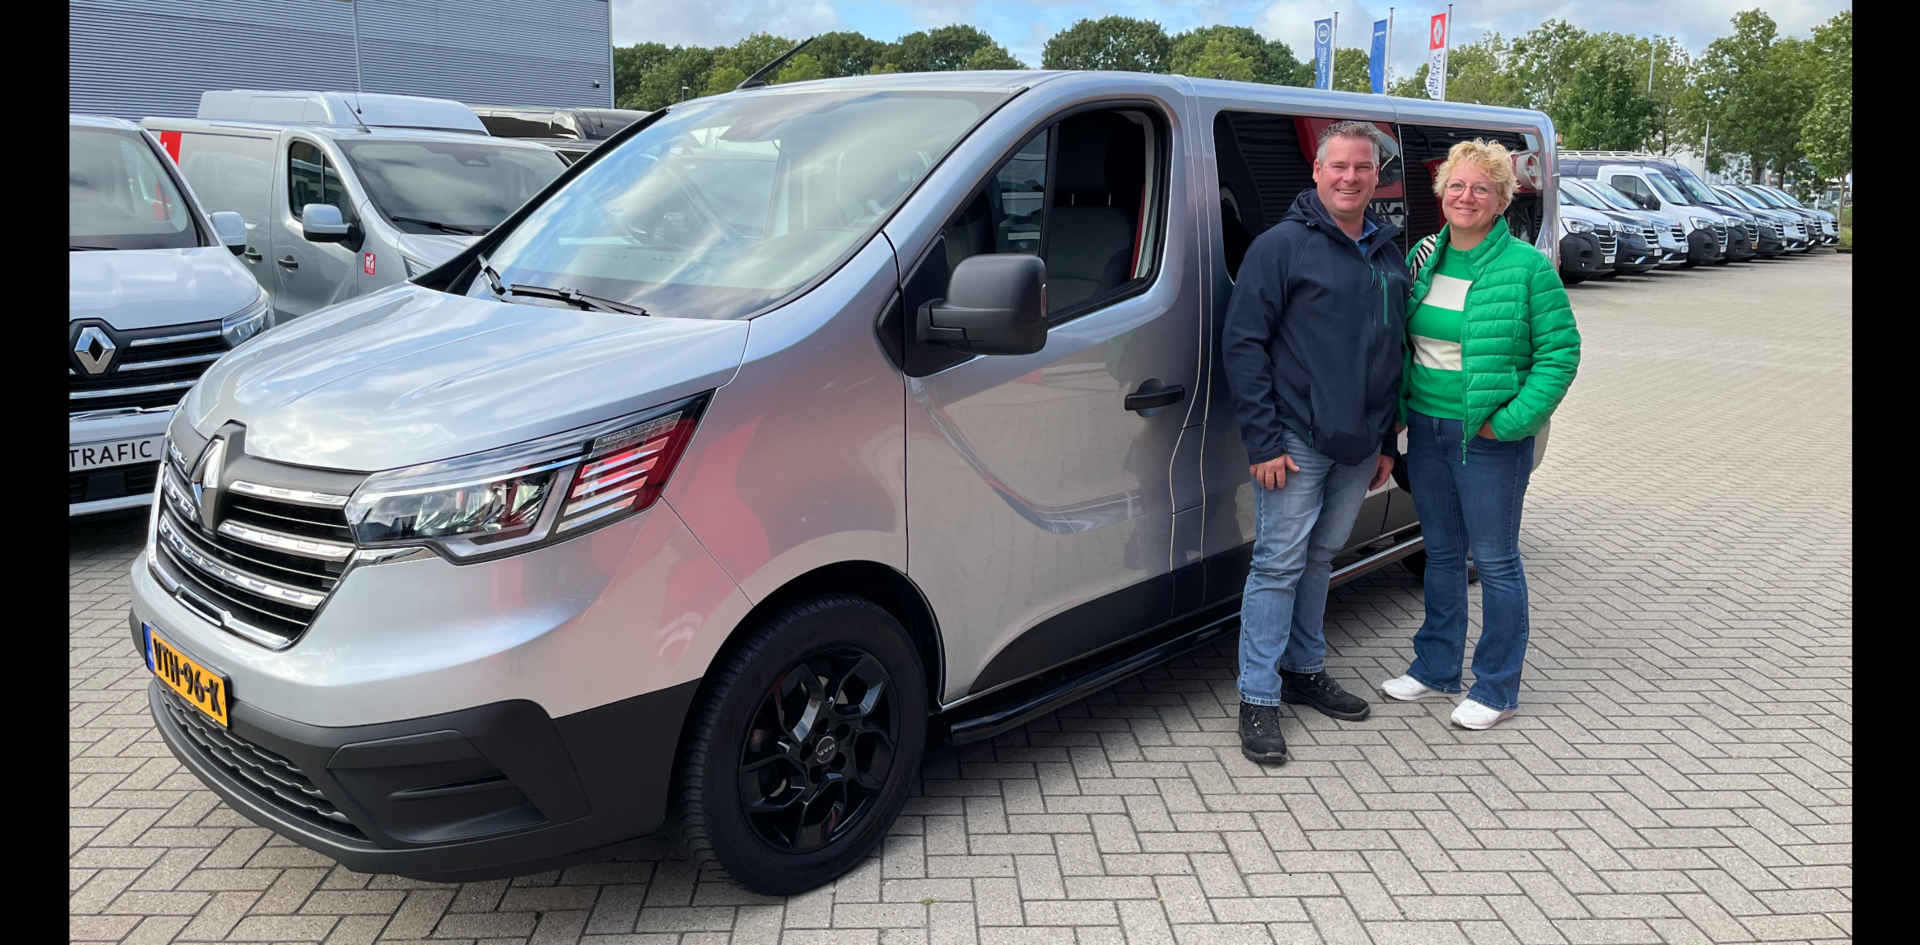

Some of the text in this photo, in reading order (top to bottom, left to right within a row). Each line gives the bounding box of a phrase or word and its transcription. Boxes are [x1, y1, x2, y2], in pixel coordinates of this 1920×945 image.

[602, 430, 632, 443] RENAULT
[69, 441, 152, 467] TRAFIC
[153, 638, 223, 717] VTH-96-K
